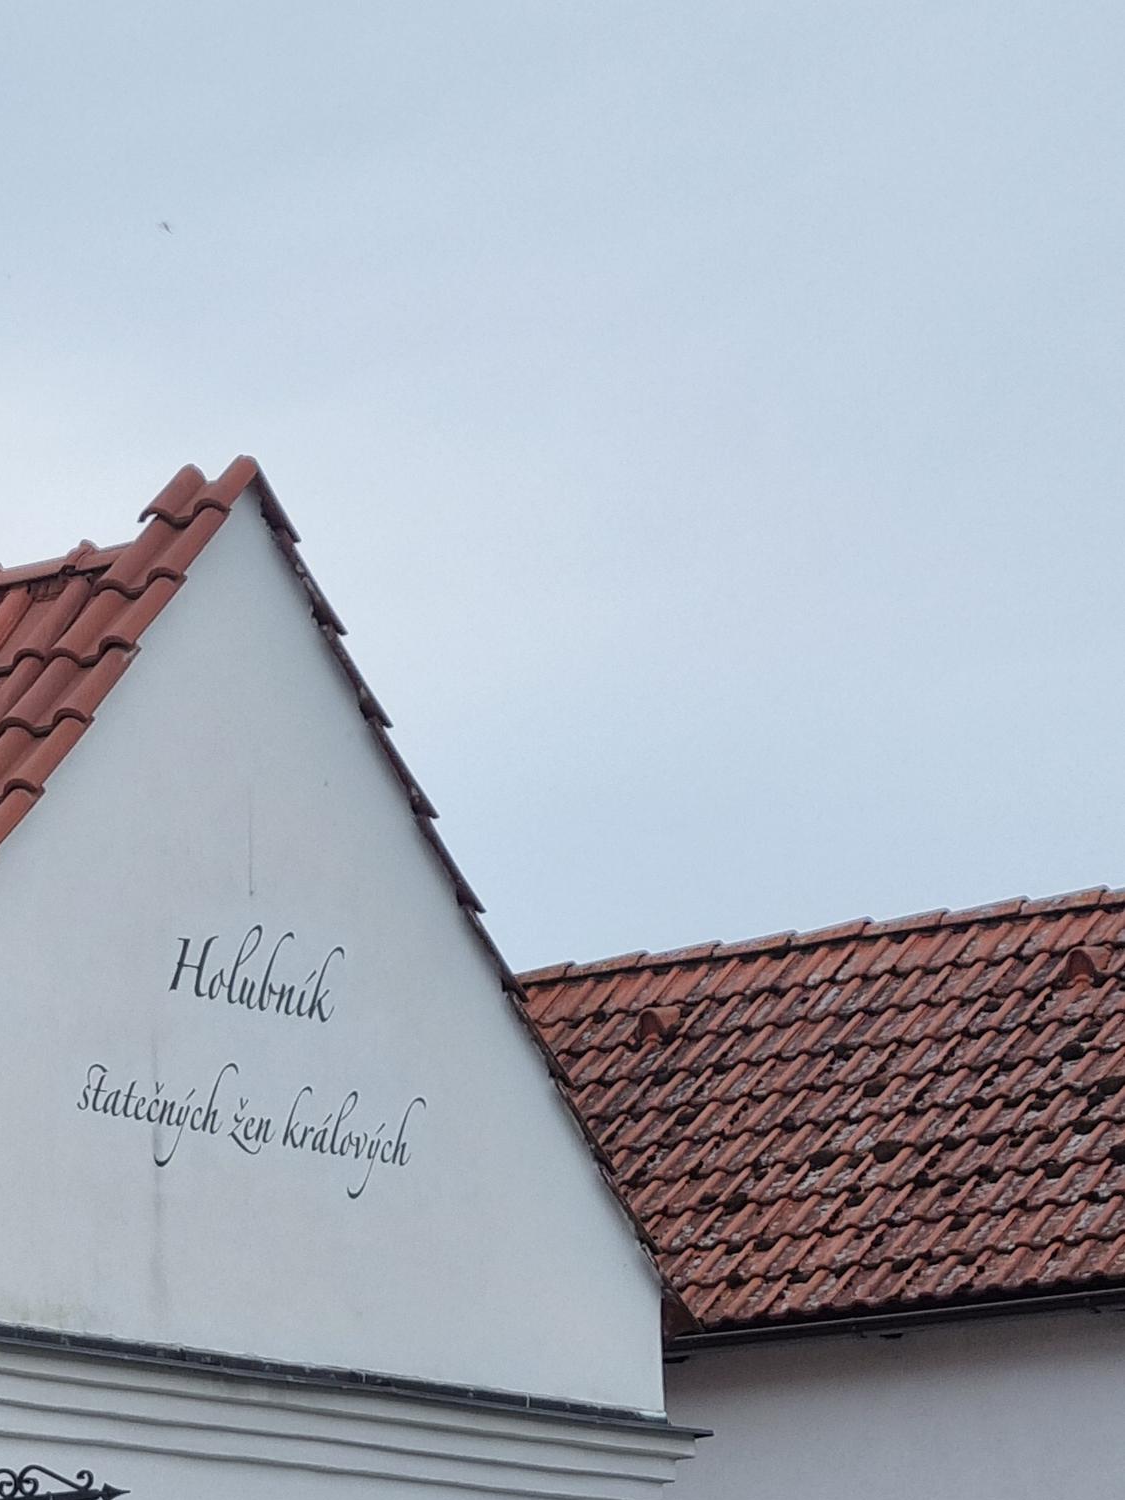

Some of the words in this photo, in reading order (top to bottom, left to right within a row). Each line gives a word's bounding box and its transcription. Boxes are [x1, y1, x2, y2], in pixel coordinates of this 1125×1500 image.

[169, 925, 345, 1022] Holubník
[228, 1097, 275, 1155] žen
[282, 1086, 427, 1199] králových
